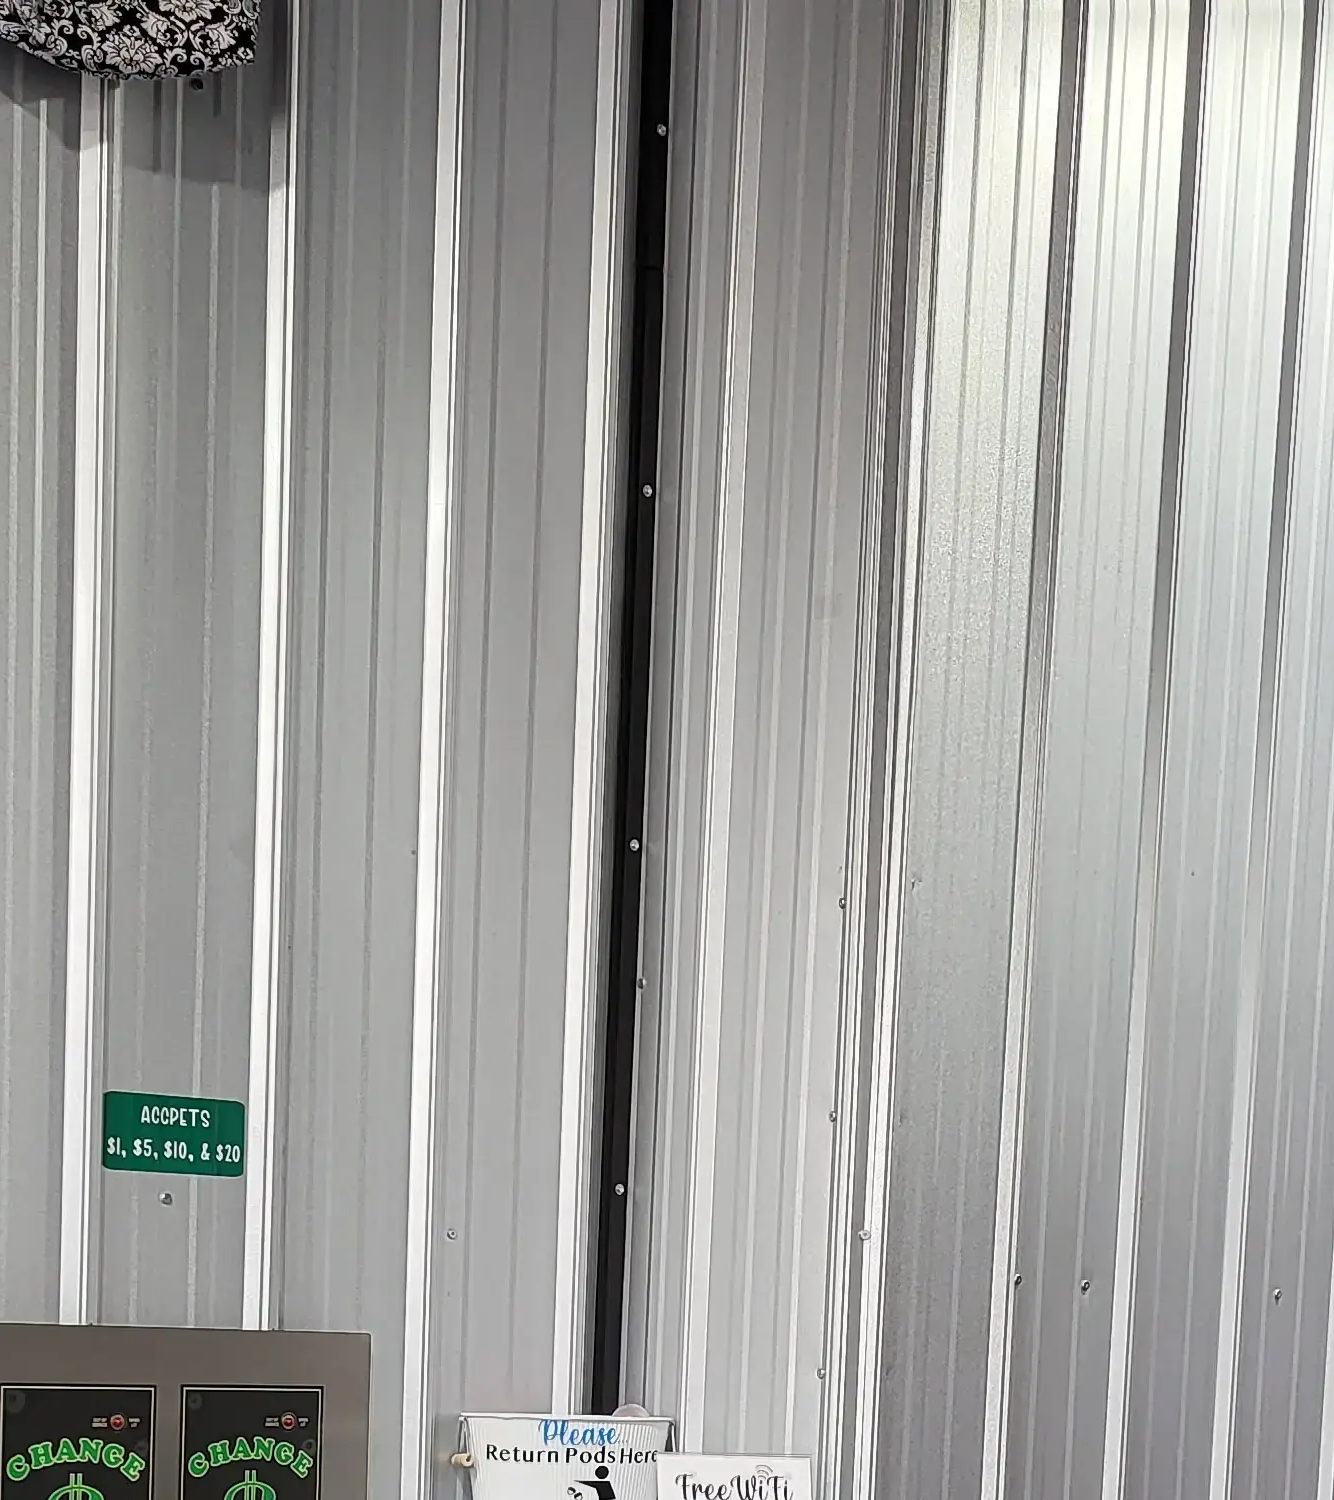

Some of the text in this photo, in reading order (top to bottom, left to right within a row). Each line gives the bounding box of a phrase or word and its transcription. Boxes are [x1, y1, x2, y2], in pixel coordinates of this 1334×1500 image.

[140, 1105, 211, 1128] ACCPETS
[132, 1138, 159, 1160] $5,
[163, 1140, 194, 1162] $10,
[200, 1142, 211, 1161] &
[215, 1144, 241, 1163] $20
[6, 1437, 146, 1481] CHANGE
[188, 1436, 314, 1479] CHANGE
[485, 1443, 559, 1463] Return
[565, 1446, 616, 1464] Pods
